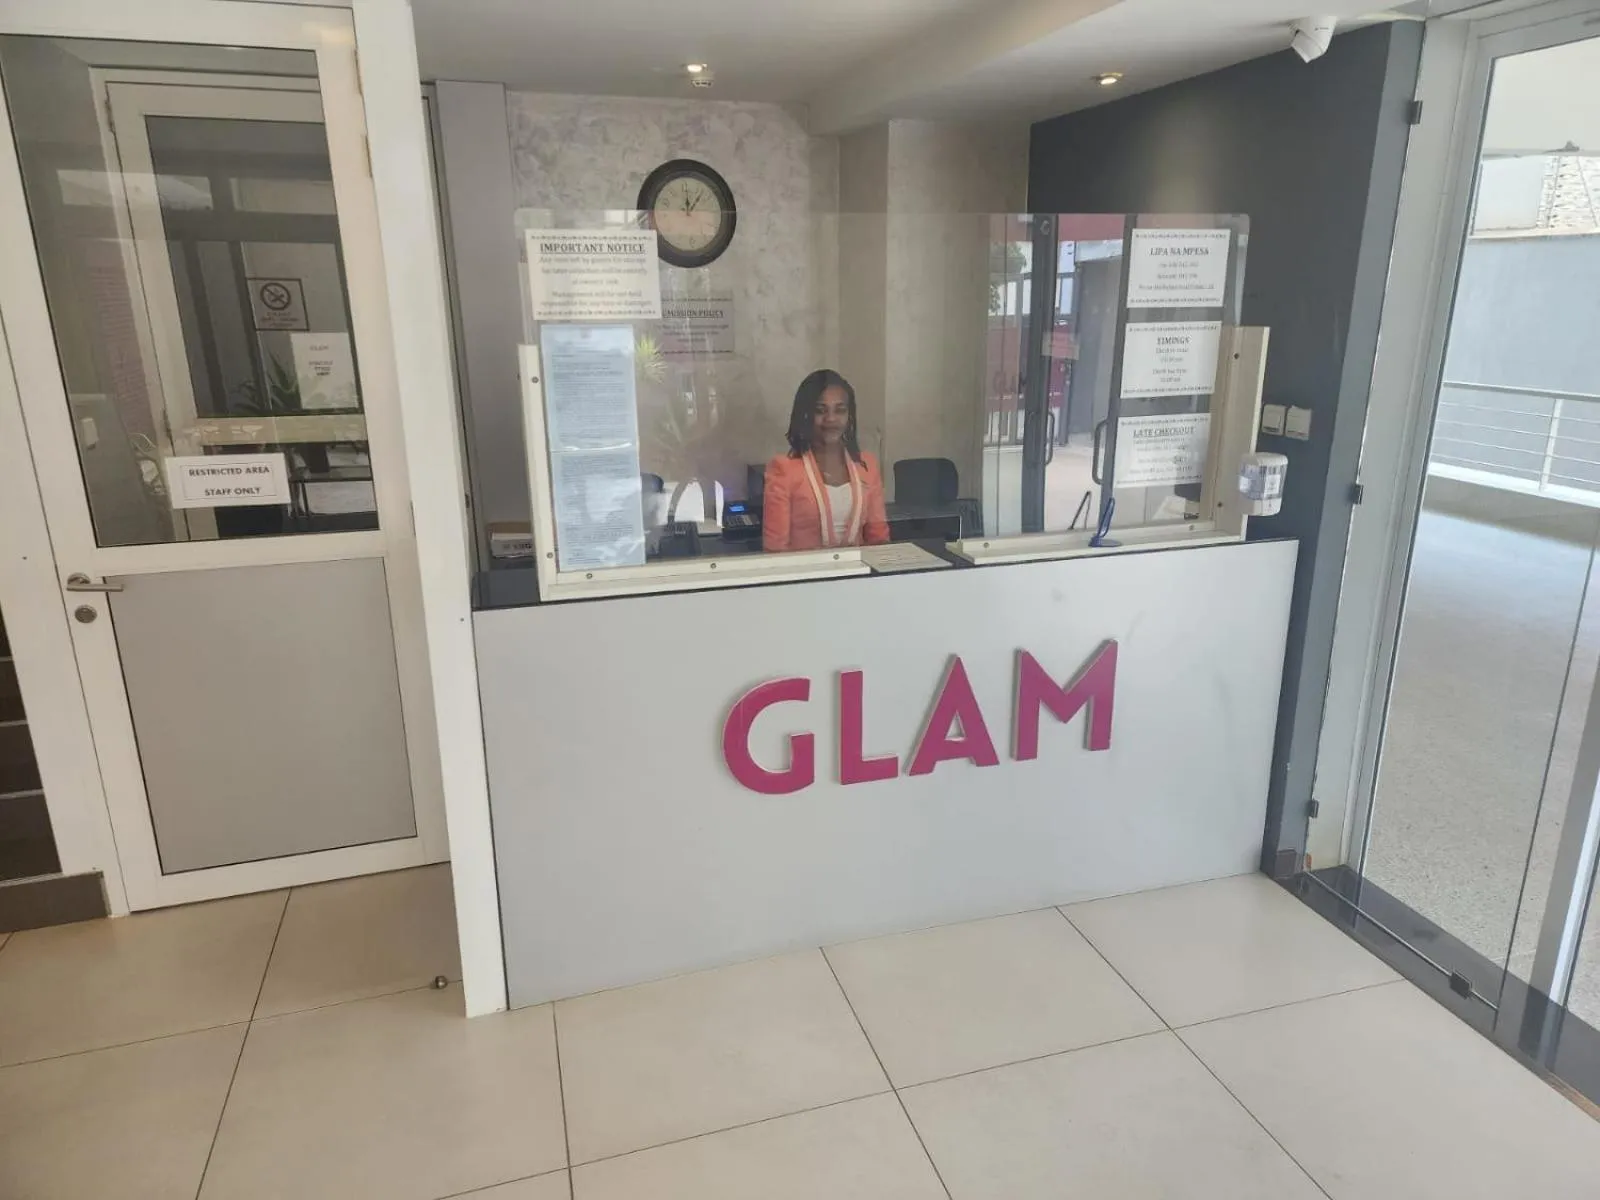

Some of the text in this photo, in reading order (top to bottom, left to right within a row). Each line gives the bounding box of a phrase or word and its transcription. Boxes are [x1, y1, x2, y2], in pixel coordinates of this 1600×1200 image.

[539, 243, 645, 252] IMPORTANT NOTICE
[1182, 246, 1209, 256] MPESA
[1156, 336, 1190, 345] TIMINGS
[1133, 426, 1195, 438] LATE CHECKOUT
[188, 466, 270, 477] RESTRICTED AREA
[204, 487, 261, 496] STAFF ONLY
[721, 638, 1118, 795] GLAM
